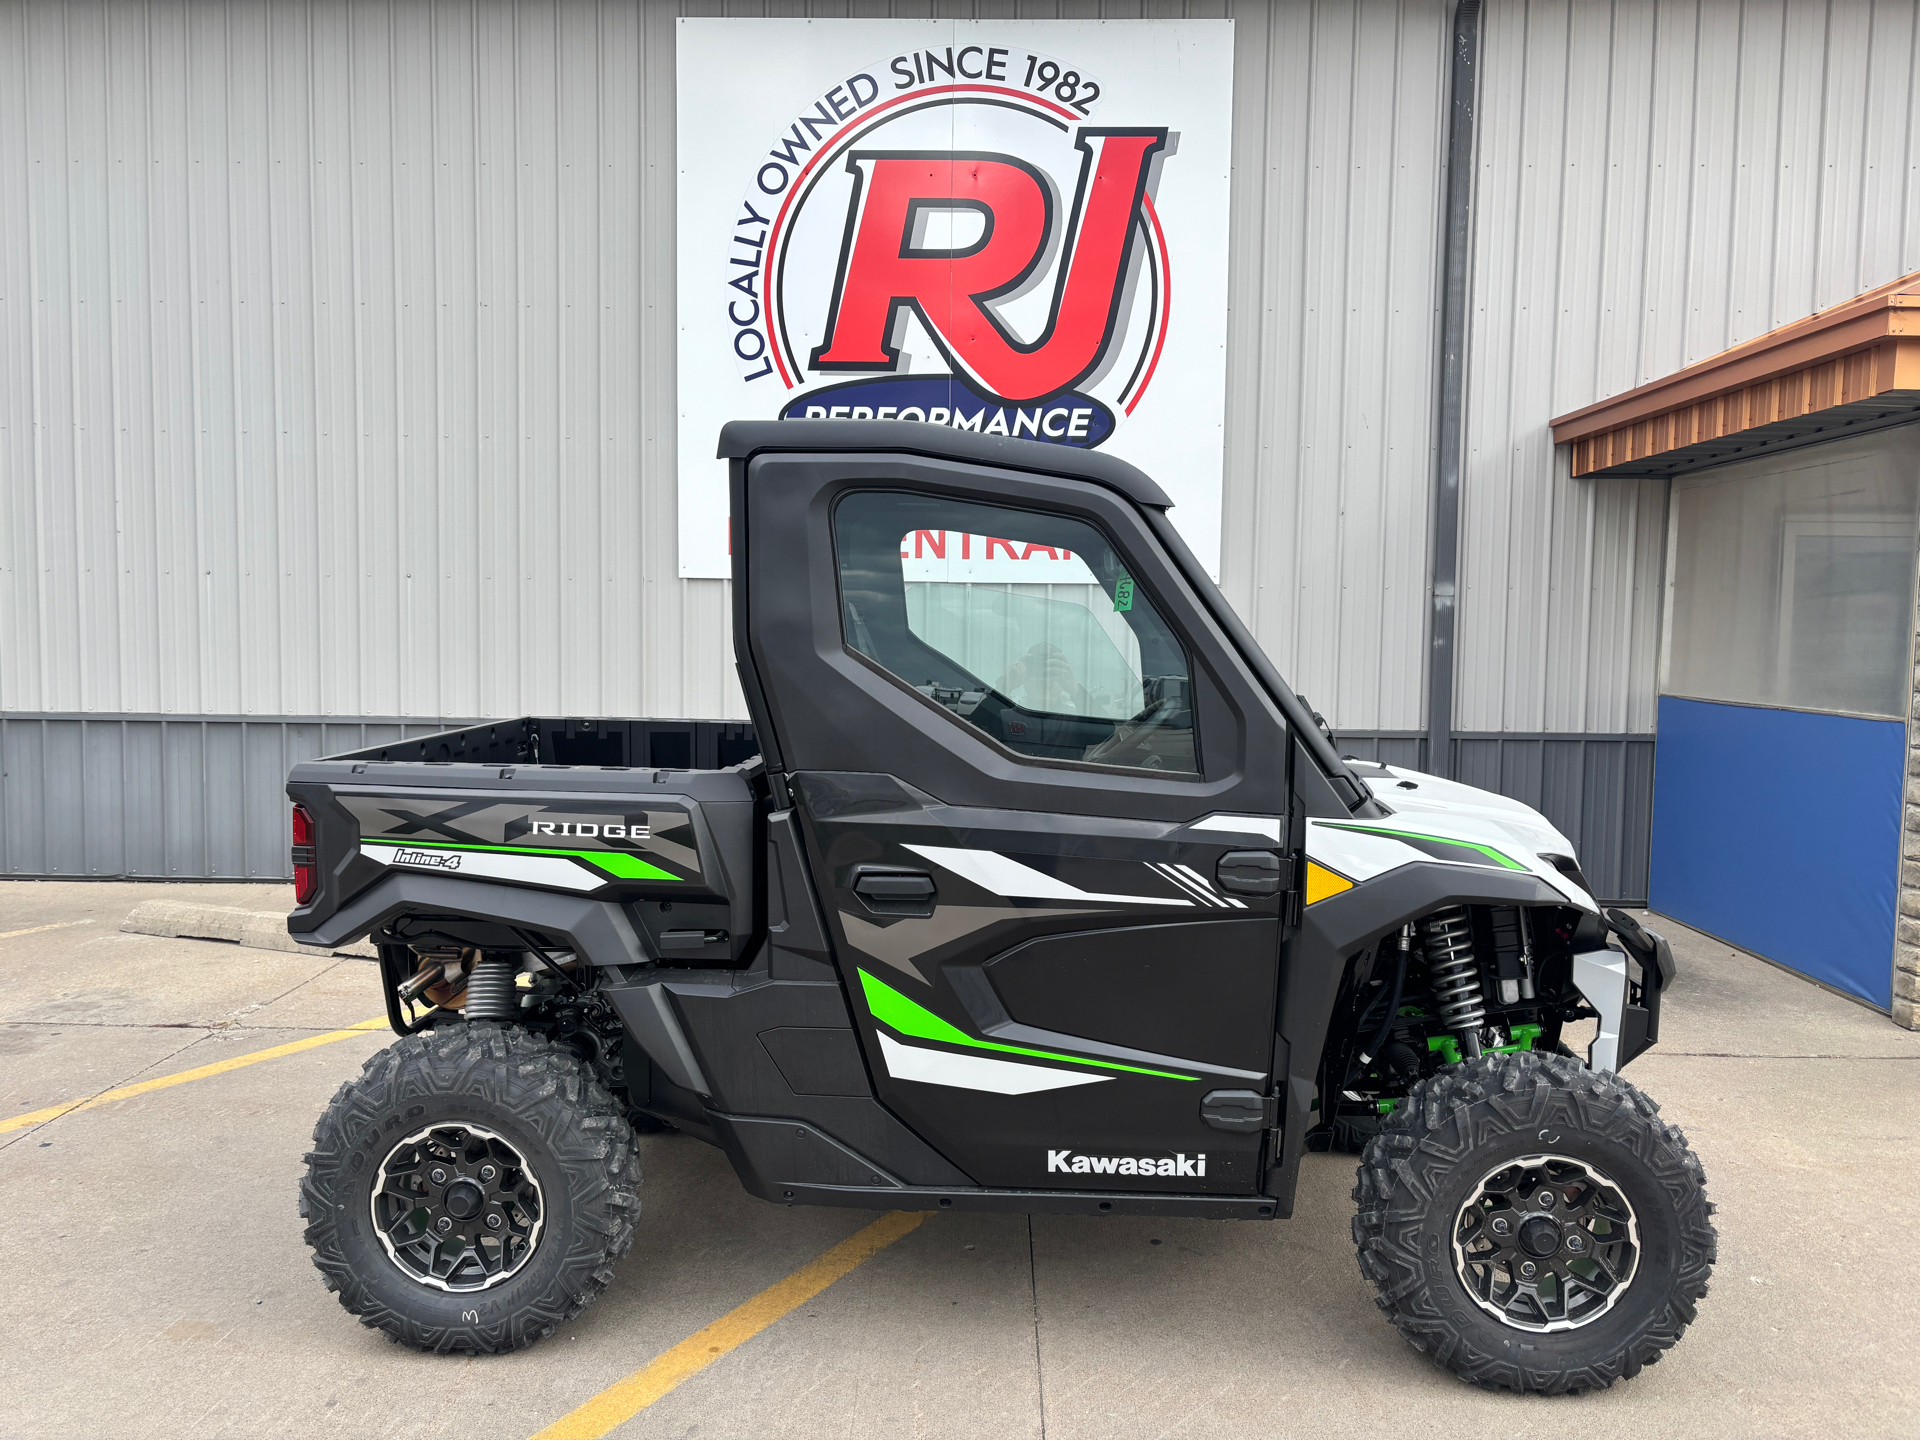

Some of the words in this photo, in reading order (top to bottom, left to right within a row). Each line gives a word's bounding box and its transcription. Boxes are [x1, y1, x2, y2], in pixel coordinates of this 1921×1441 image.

[727, 200, 774, 383] LOCALLY
[757, 73, 879, 195] OWNED
[890, 46, 1009, 90] SINCE
[1023, 54, 1101, 116] 1982
[808, 126, 1170, 406] RJ
[532, 820, 651, 839] RIDGE
[392, 848, 462, 870] Inline-4
[1047, 1150, 1206, 1177] Kawasaki
